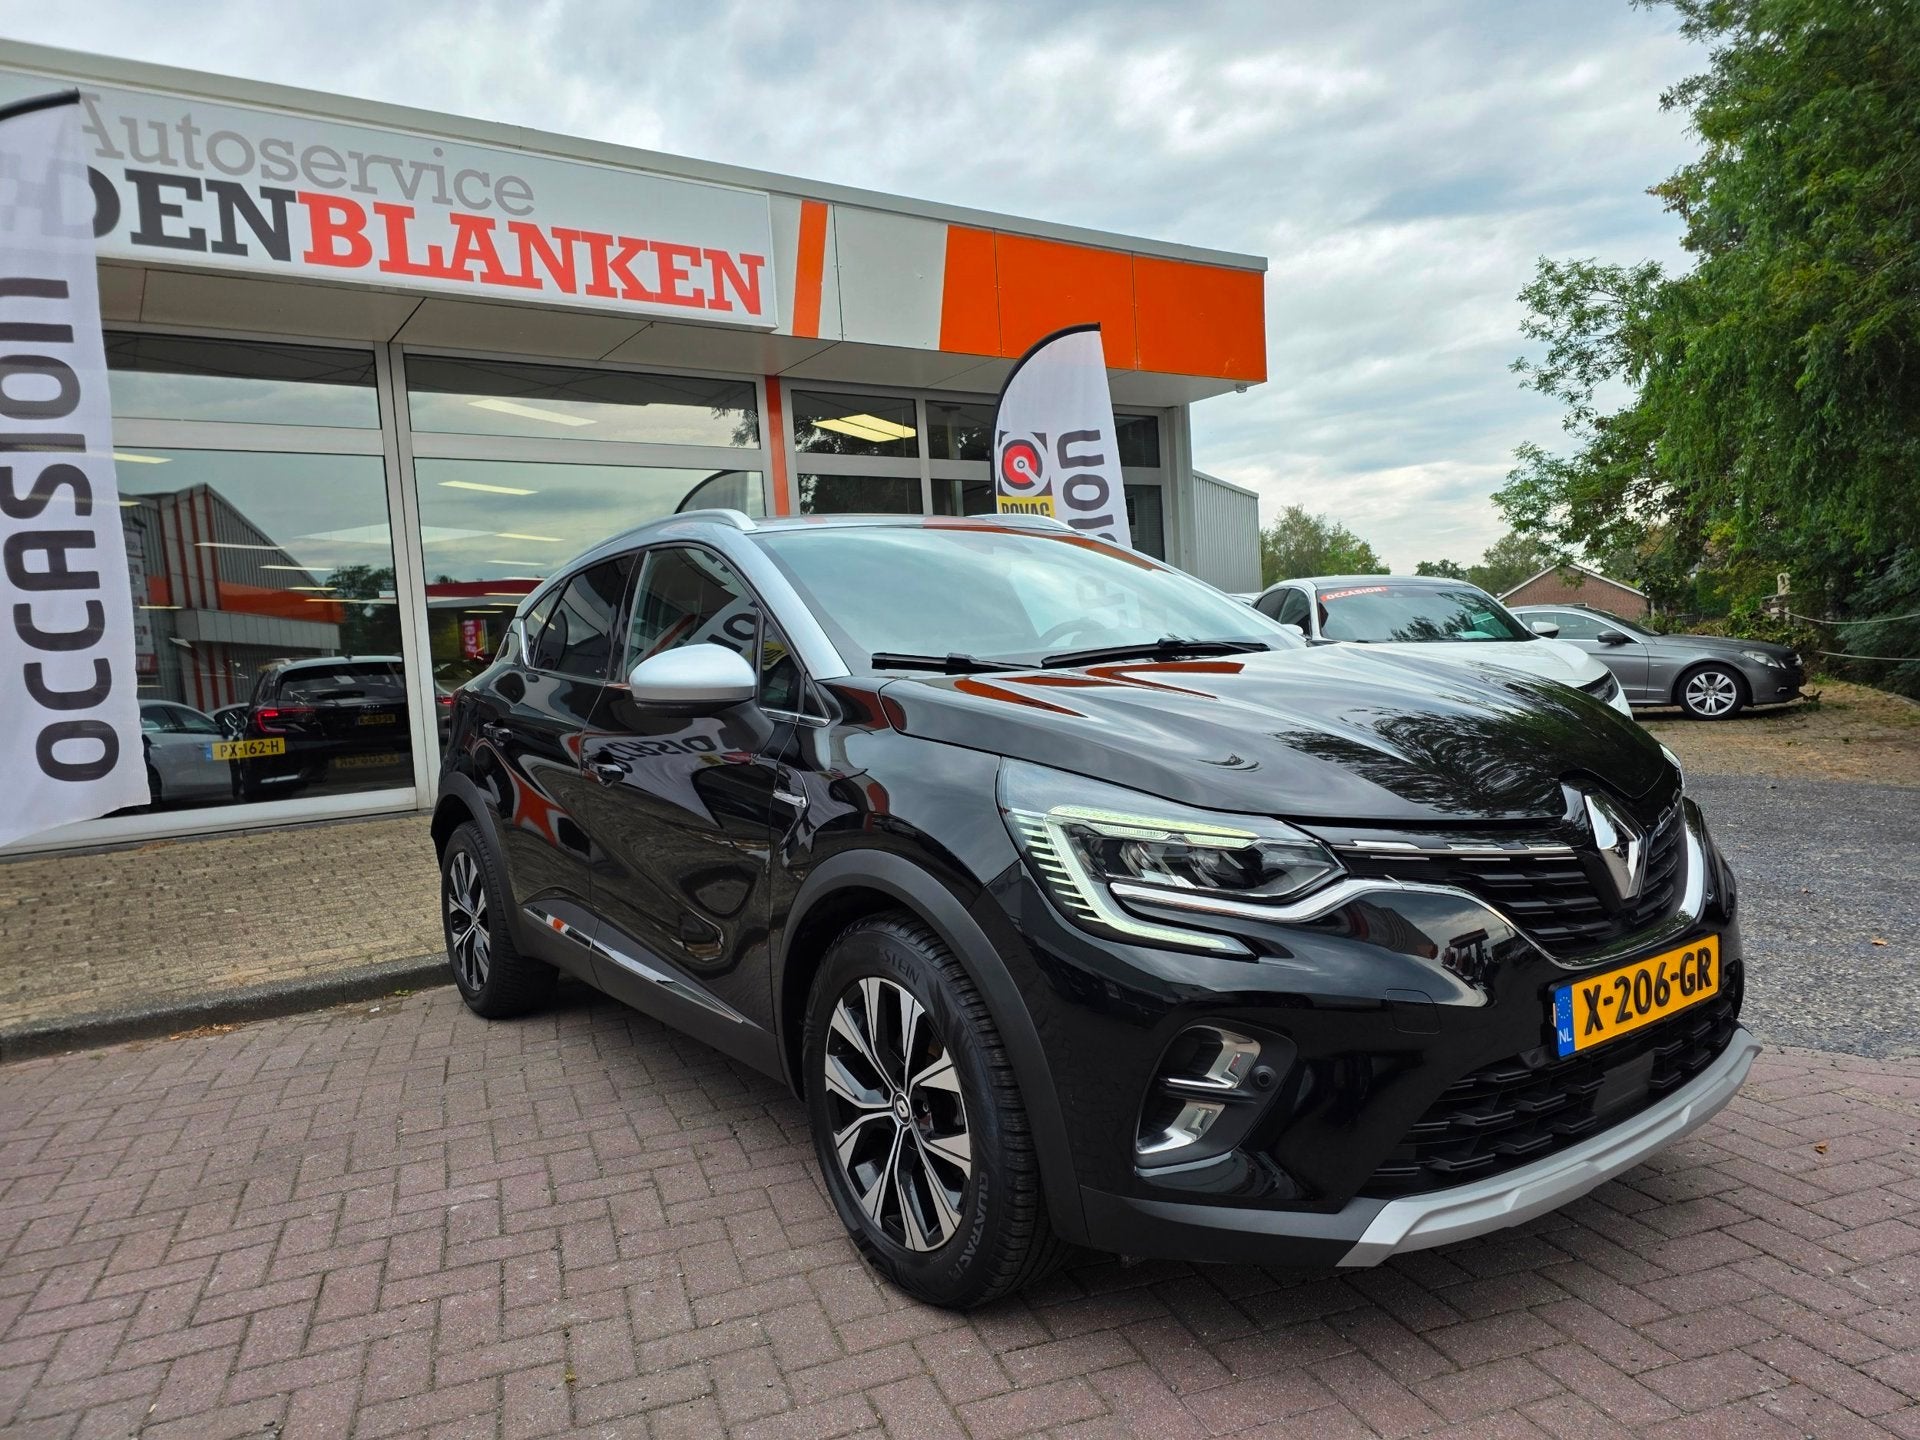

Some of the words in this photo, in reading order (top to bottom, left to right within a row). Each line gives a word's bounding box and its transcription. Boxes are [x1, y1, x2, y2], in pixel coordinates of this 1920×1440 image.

[80, 92, 535, 216] Autoservice
[1326, 586, 1382, 600] OCCASION
[220, 740, 280, 758] PX-162-H
[1582, 946, 1713, 1036] X-206-GR
[1558, 1028, 1573, 1045] NL
